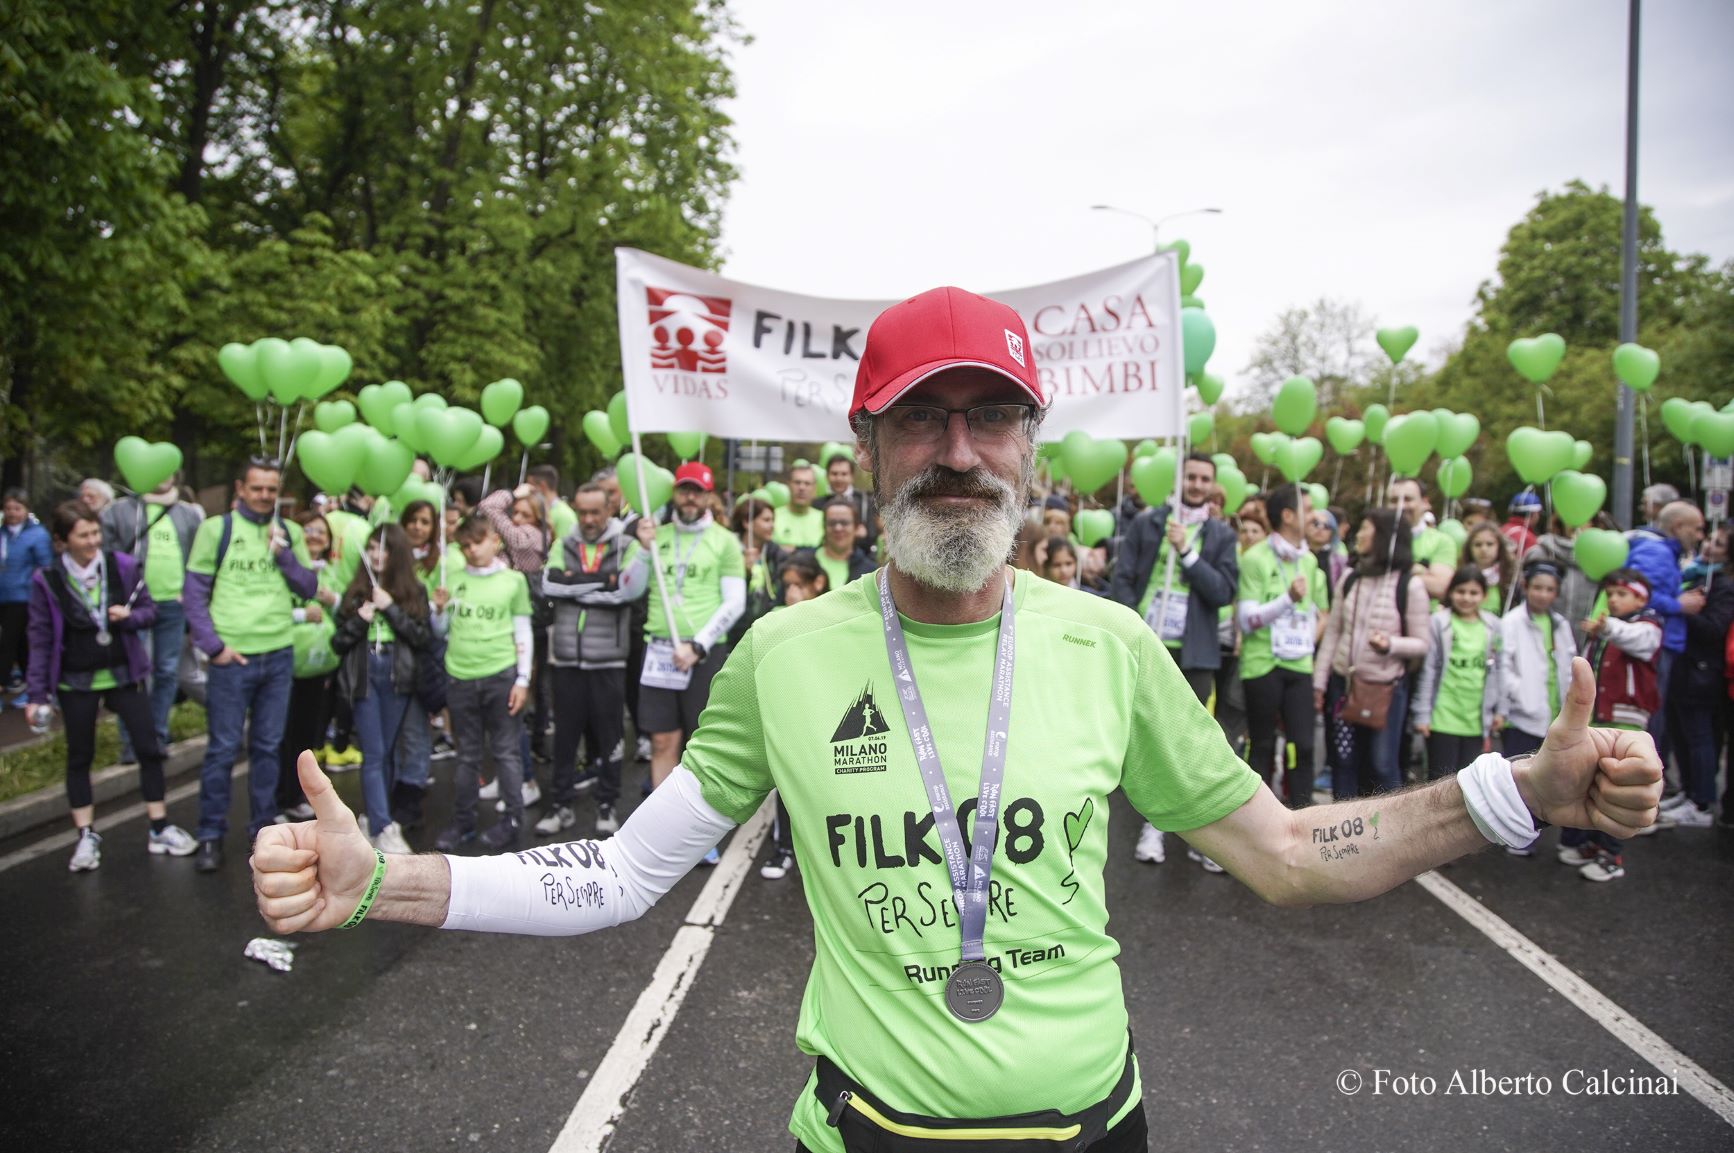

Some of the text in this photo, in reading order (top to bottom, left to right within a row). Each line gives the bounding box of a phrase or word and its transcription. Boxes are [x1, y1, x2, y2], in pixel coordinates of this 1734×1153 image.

[1033, 293, 1155, 337] CASA
[753, 310, 861, 361] FILK
[1033, 334, 1160, 362] SOLLIEVO
[652, 373, 729, 400] VIDAS
[1038, 360, 1160, 396] BIMBI
[1006, 635, 1014, 661] EUROP
[1062, 634, 1097, 649] RUNNEK
[997, 633, 1008, 702] RELAY MARATHON
[1003, 661, 1013, 708] ASSISTANCE
[834, 743, 888, 758] MILANO
[912, 727, 923, 745] FAST
[834, 755, 888, 767] MARATHON
[836, 767, 859, 775] CHARITY
[979, 783, 990, 817] LIVE COOL
[987, 800, 998, 818] FAST
[826, 797, 1044, 869] FILK 08
[1312, 817, 1364, 844] FILK 08
[515, 840, 606, 870] FILK 08
[944, 838, 960, 887] ASSISTANCE
[952, 841, 968, 890] MARATHON
[540, 872, 605, 911] PER SEMPRE
[353, 904, 368, 921] FILK
[858, 882, 922, 937] PER
[916, 880, 1018, 929] SERE
[905, 943, 1066, 984] Rung Team
